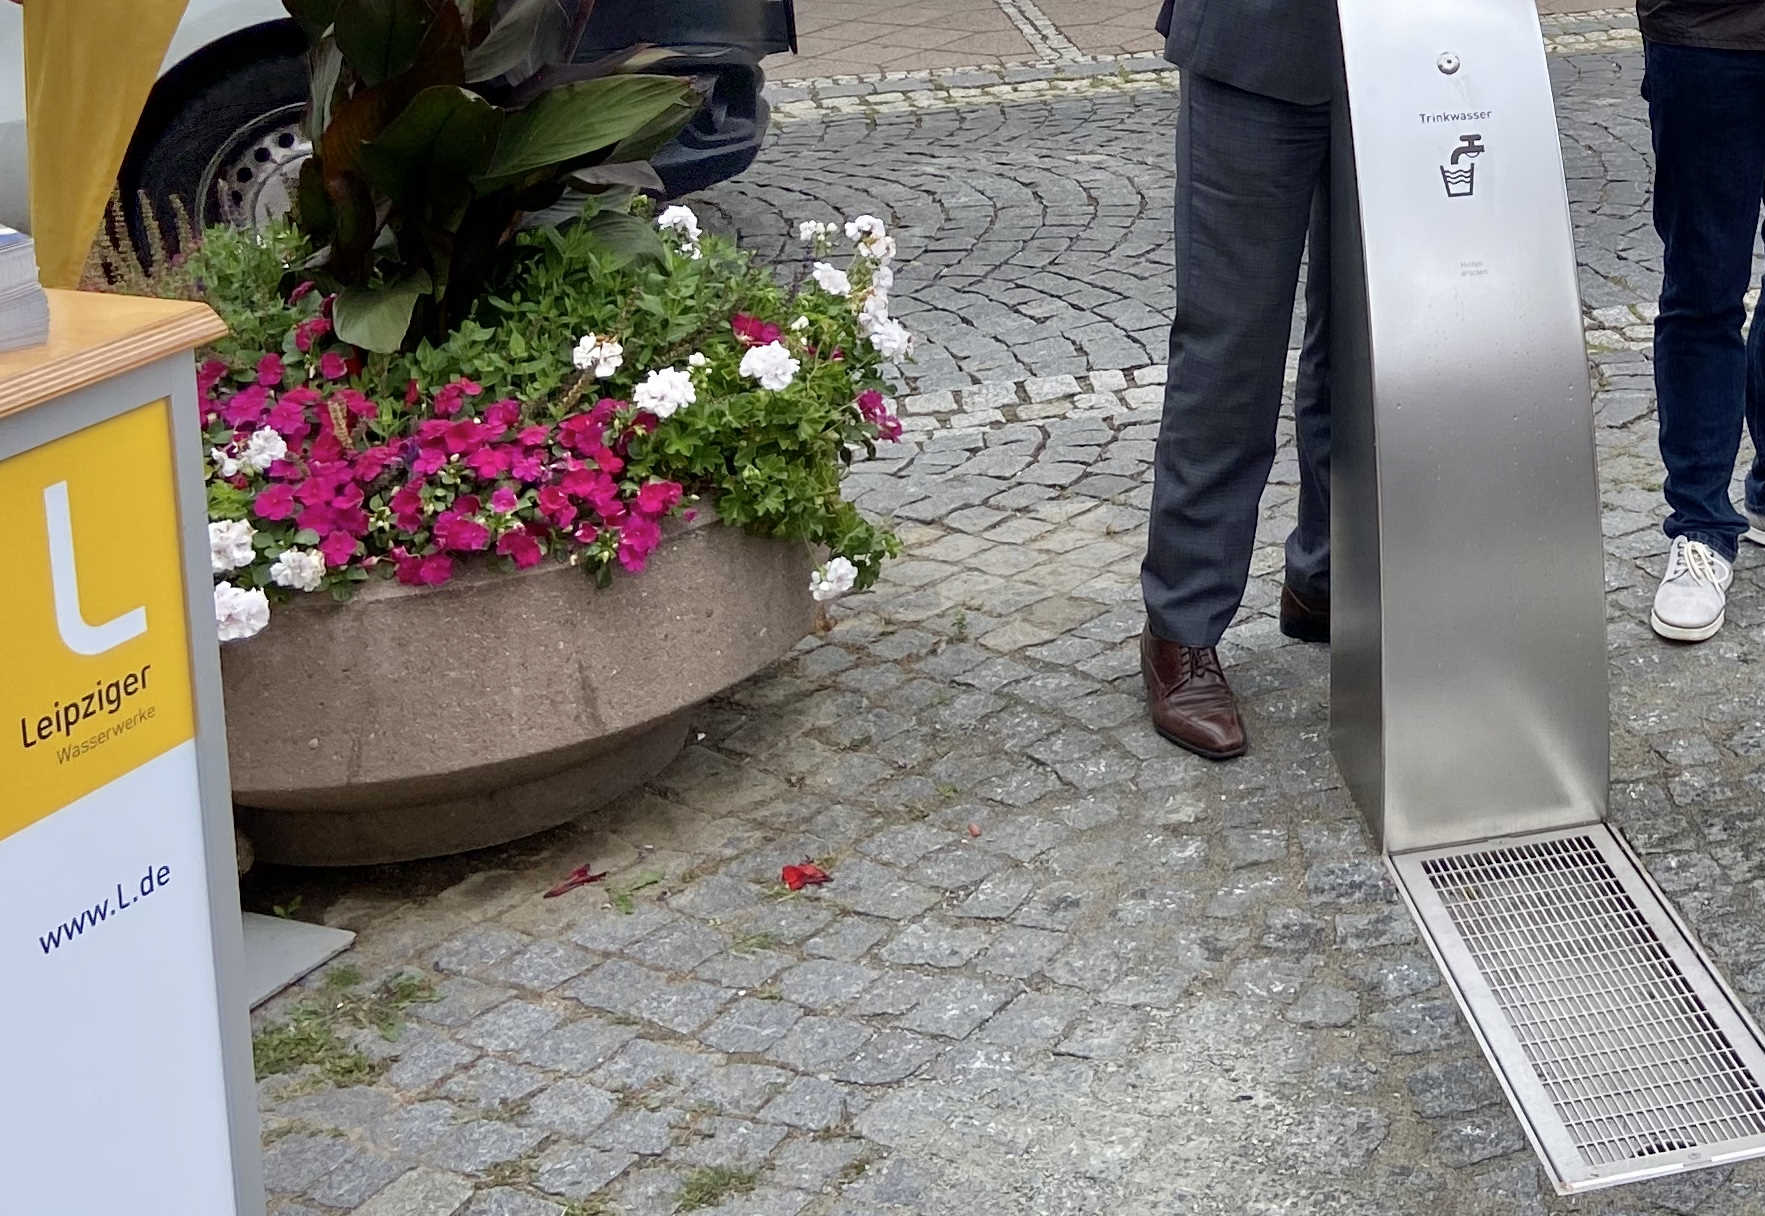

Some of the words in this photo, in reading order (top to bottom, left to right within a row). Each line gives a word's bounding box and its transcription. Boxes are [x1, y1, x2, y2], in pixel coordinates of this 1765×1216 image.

[1418, 109, 1493, 124] Trinkwasser
[21, 663, 153, 749] Leipziger
[56, 704, 157, 766] Wasserwerke
[38, 862, 171, 955] www.L.de
